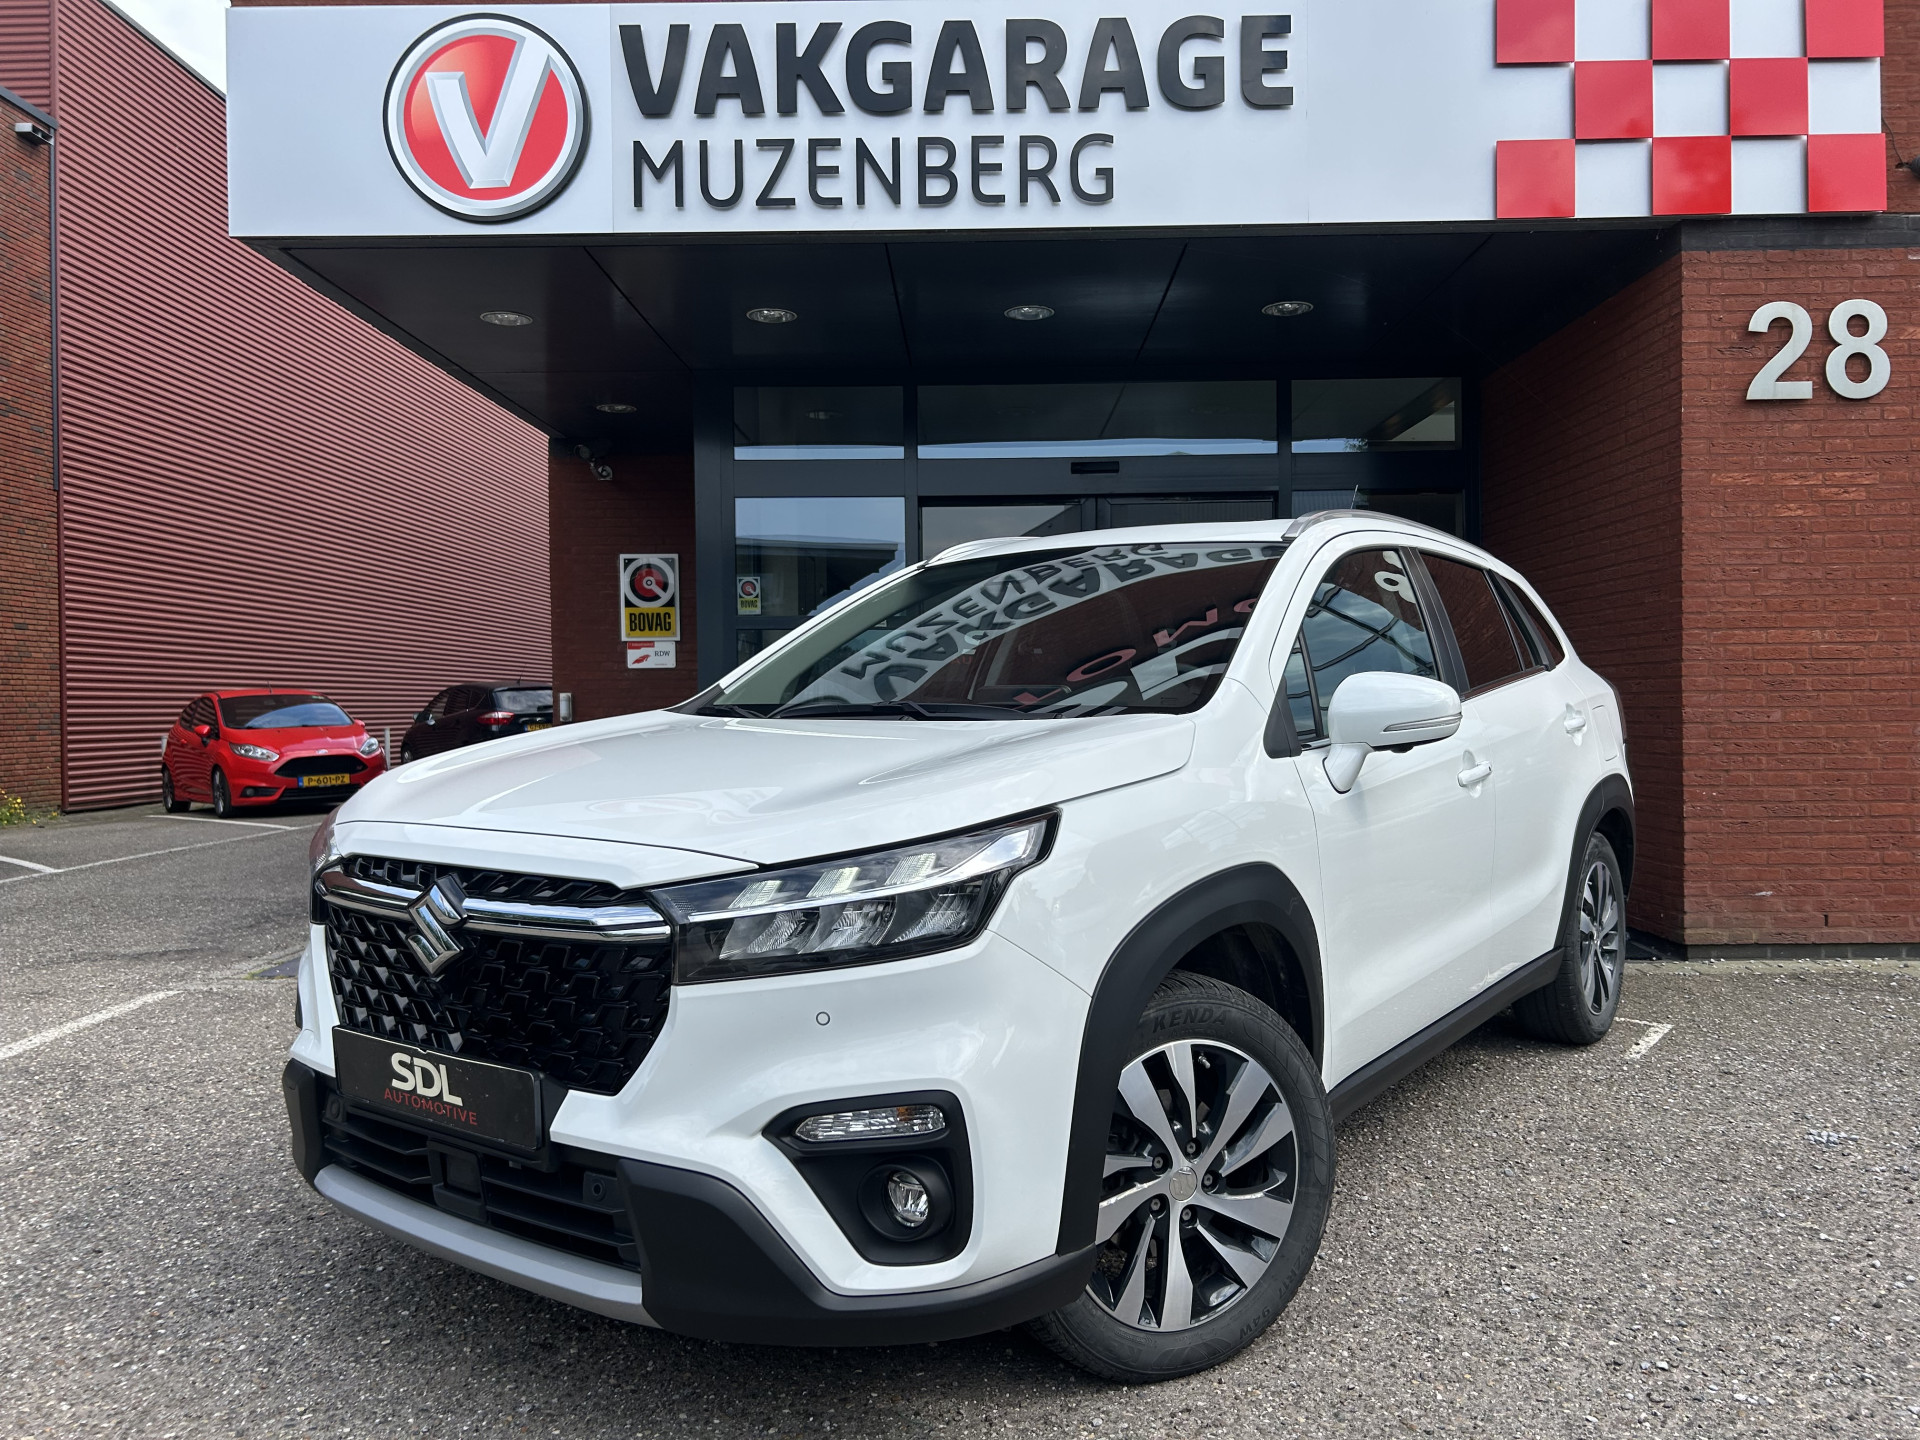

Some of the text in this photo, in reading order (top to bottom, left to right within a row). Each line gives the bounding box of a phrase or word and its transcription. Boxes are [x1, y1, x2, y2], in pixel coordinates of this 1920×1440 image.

[618, 14, 1293, 117] VAKGARAGE
[633, 133, 1115, 208] MUZENBERG
[1746, 298, 1891, 400] 28
[629, 612, 671, 632] BOVAG
[741, 600, 758, 608] BOVAG
[307, 775, 346, 785] P-601-PZ
[1152, 1007, 1229, 1033] KENDA
[391, 1052, 463, 1106] SDL
[384, 1087, 477, 1125] AUTOMOTIVE
